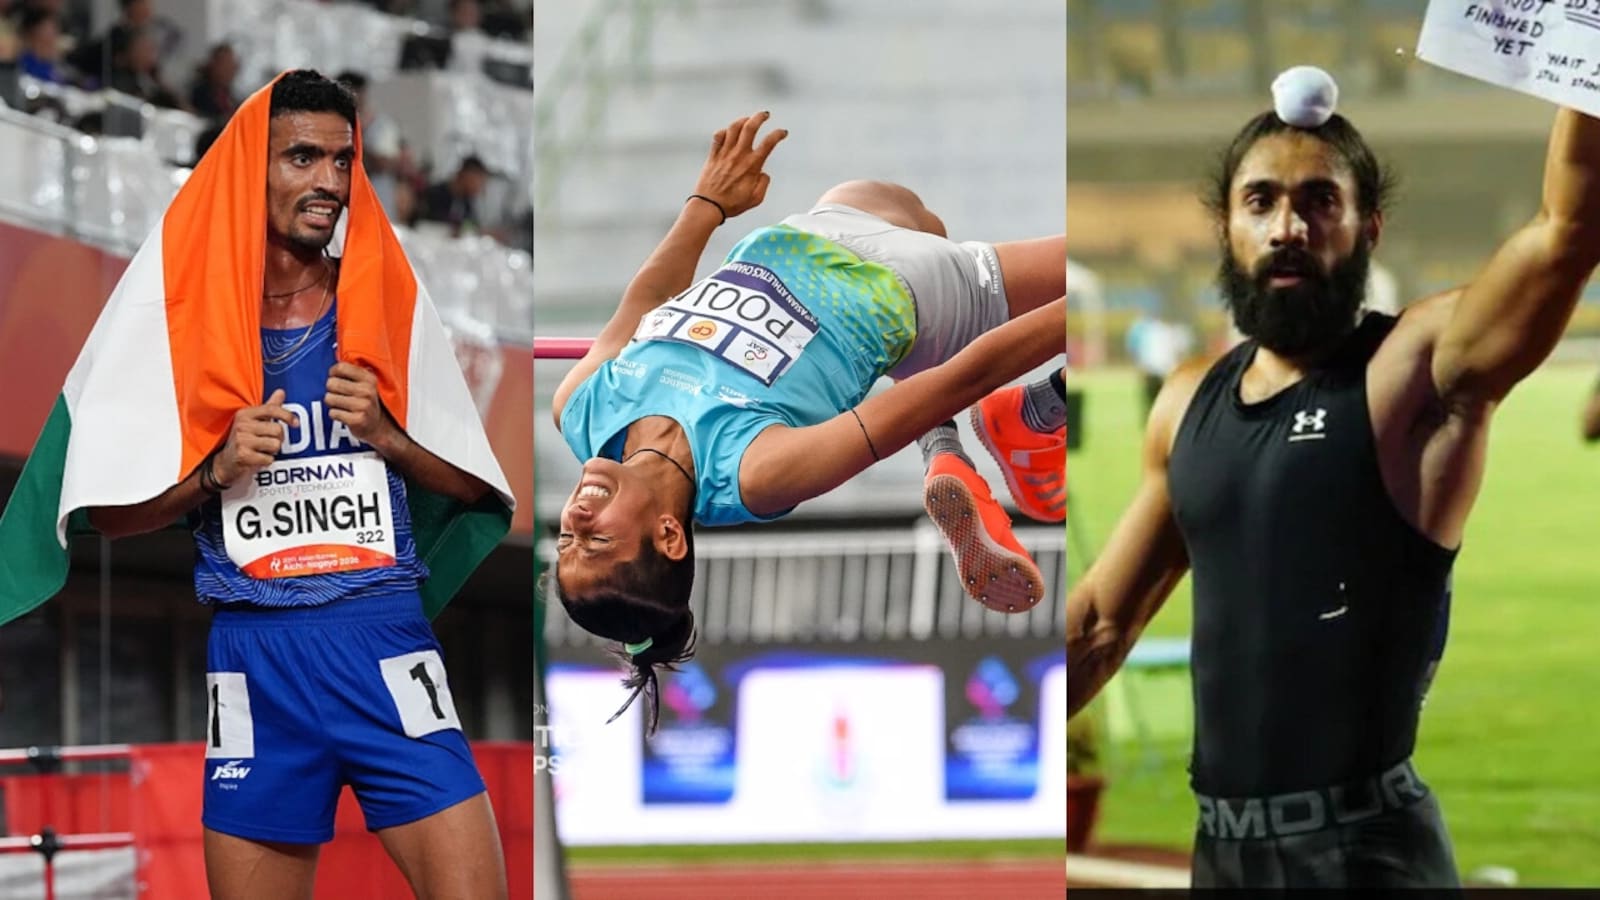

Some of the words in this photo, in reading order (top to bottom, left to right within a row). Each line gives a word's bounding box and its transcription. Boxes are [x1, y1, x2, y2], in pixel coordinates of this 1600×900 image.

[1465, 5, 1544, 38] FINISHED
[1493, 36, 1534, 56] YET
[1547, 52, 1586, 69] WAIT
[752, 267, 788, 297] ATHLETICS
[786, 295, 807, 316] ASIAN
[692, 325, 713, 337] CP
[277, 401, 361, 454] DIA
[255, 462, 355, 487] BORNAN
[259, 486, 293, 497] SPORTS
[296, 480, 356, 494] TECHNOLOGY
[236, 492, 381, 540] G.SINGH
[356, 530, 385, 544] 322
[409, 661, 445, 719] 1
[211, 683, 222, 748] 1
[211, 764, 252, 780] JSW
[1197, 761, 1427, 839] RMOUR
